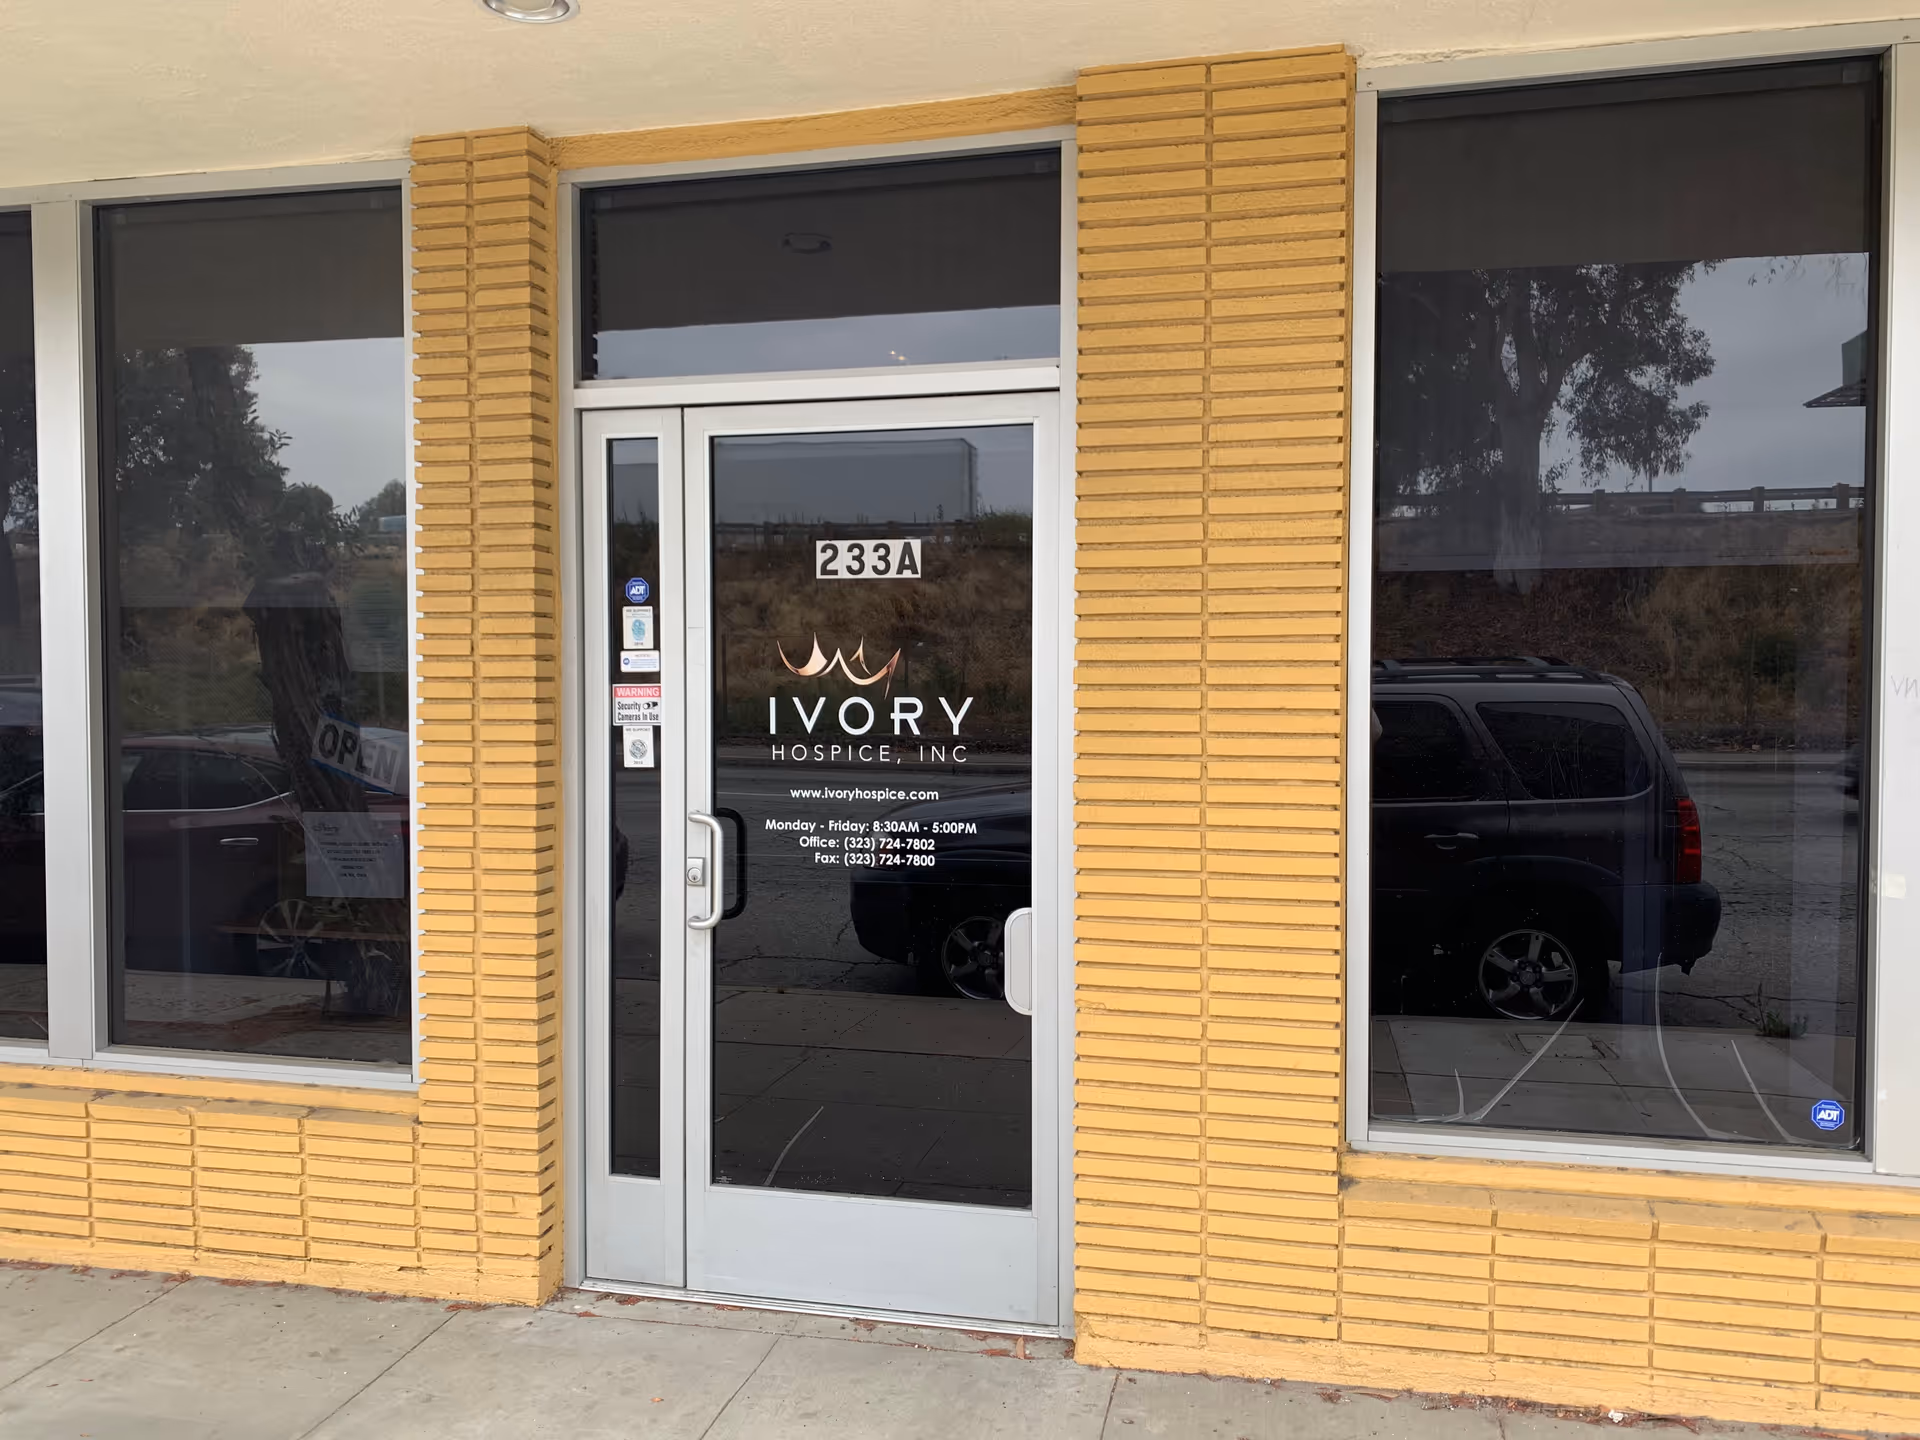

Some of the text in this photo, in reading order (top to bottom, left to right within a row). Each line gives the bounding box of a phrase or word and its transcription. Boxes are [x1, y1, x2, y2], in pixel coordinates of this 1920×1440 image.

[819, 541, 920, 576] 233A
[630, 585, 646, 595] ADT
[616, 687, 660, 697] WARNING
[617, 701, 641, 712] Security
[617, 711, 659, 721] Cameras In Use
[769, 696, 974, 736] IVORY
[318, 723, 399, 785] OPEN
[772, 745, 967, 765] HOSPICE, INC
[790, 787, 939, 802] www.ivoryhospice.com
[765, 819, 816, 833] Monday
[828, 820, 870, 833] Friday:
[872, 821, 920, 834] 8:30AM
[931, 822, 977, 835] 5:00PM
[799, 836, 935, 851] Office: (323) 724-7802
[814, 853, 935, 867] Fax: (323) 724-7800
[1817, 1109, 1839, 1121] ADT
